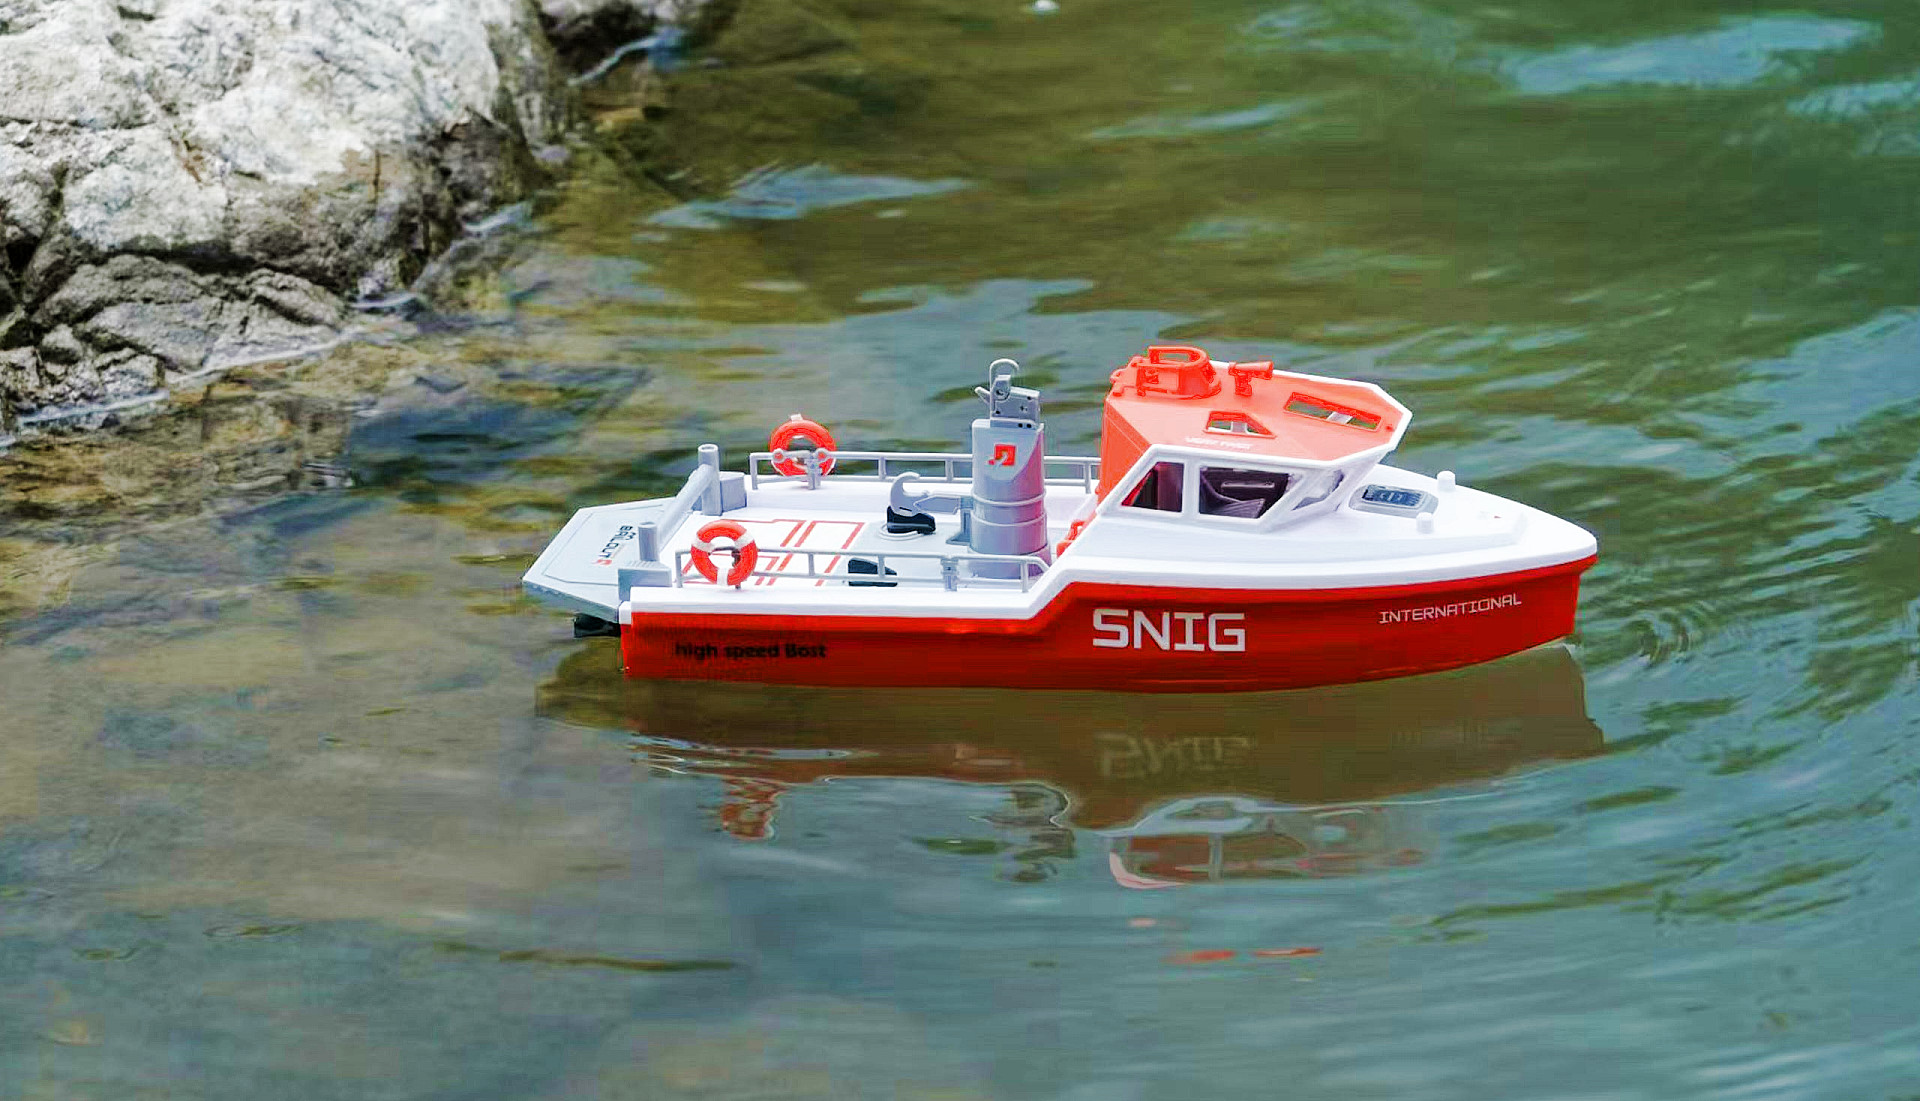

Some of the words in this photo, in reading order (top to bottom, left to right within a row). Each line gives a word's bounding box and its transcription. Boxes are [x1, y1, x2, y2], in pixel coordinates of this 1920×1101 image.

[1379, 593, 1522, 624] INTERNATIONAL
[1092, 608, 1246, 652] SNIG
[675, 642, 718, 660] high
[725, 644, 779, 659] speed
